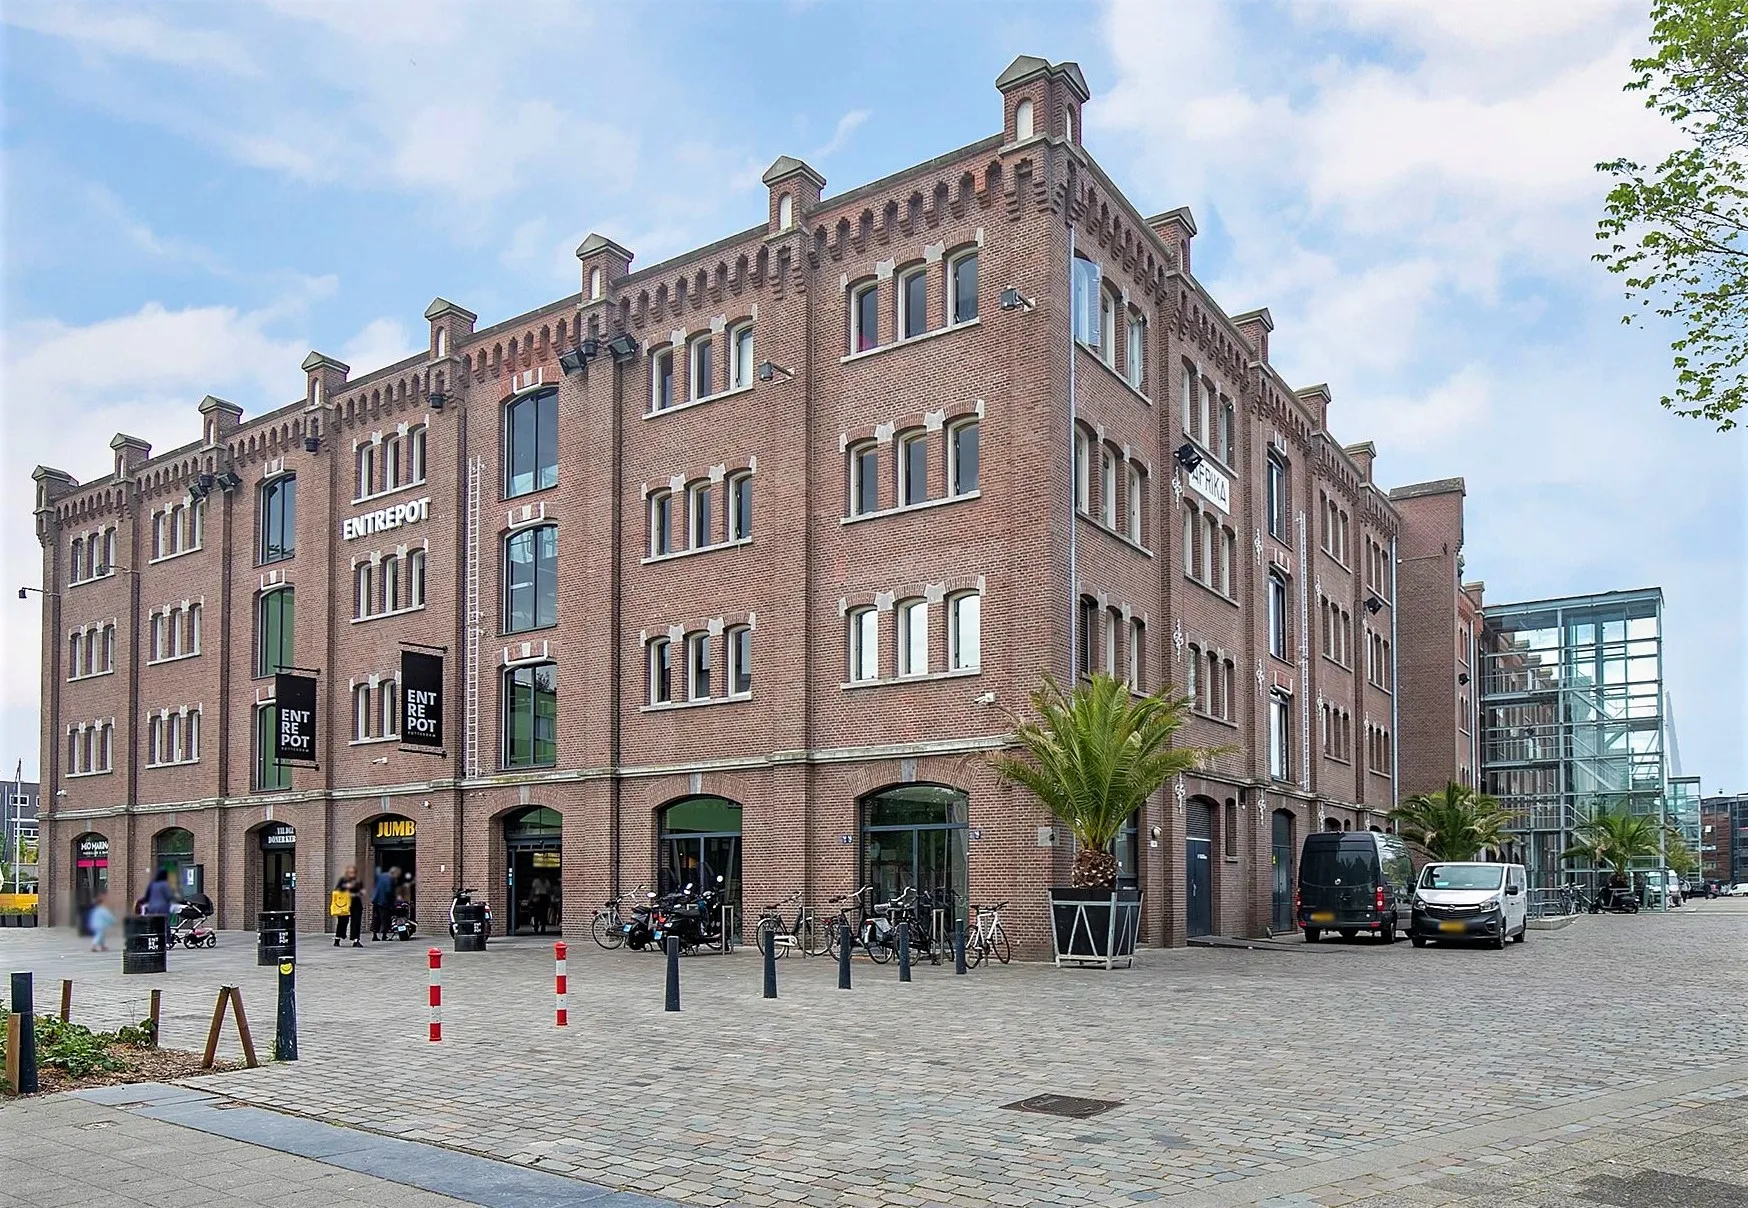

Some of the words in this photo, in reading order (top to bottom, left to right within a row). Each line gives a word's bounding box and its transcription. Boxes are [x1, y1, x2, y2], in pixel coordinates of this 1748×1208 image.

[343, 497, 431, 540] ENTREPOT
[408, 689, 437, 705] ENT
[281, 708, 310, 723] ENT
[408, 703, 426, 717] RE
[281, 721, 299, 734] RE
[408, 716, 437, 732] POT
[281, 733, 310, 748] POT
[376, 820, 415, 837] JUMB
